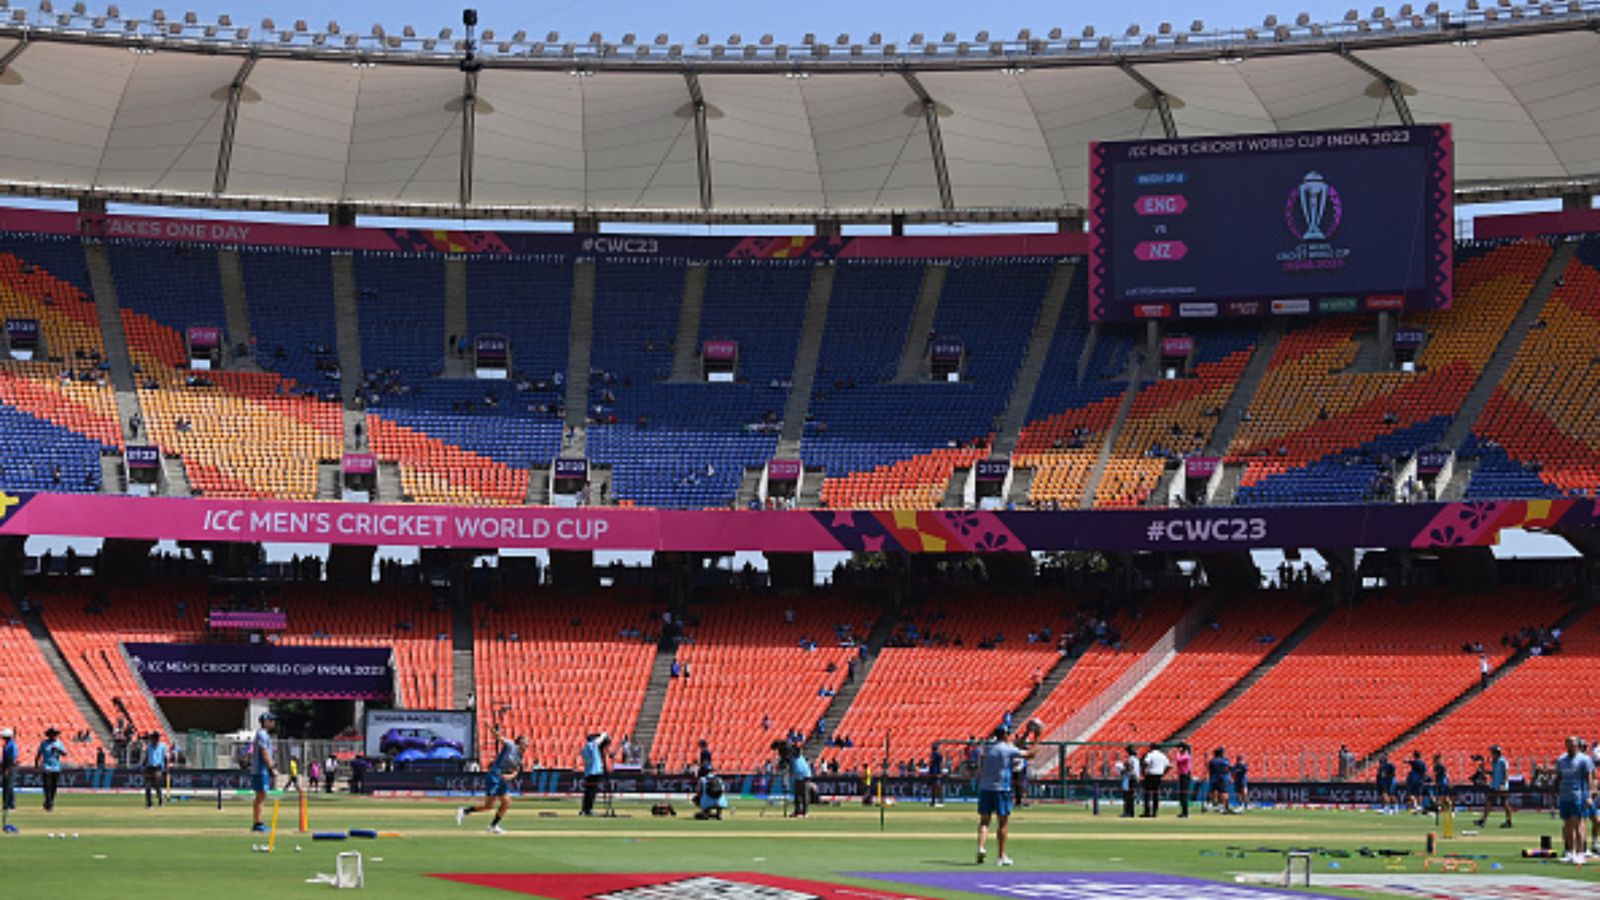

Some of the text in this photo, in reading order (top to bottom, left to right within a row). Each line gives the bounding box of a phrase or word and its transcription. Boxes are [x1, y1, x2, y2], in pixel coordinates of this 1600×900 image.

[1190, 141, 1243, 154] CRICKET
[1247, 138, 1295, 150] WORLD
[1298, 135, 1325, 148] CUP
[1327, 133, 1369, 146] INDIA
[1370, 130, 1410, 144] 2023
[1144, 198, 1177, 213] ENG
[166, 222, 206, 238] ONE
[211, 224, 249, 240] DAY
[581, 238, 659, 253] #CWC23
[1149, 242, 1172, 258] NZ
[203, 509, 609, 540] ICC MEN'S CRICKET WORLD CUP
[1146, 518, 1267, 541] #CWC23
[201, 662, 248, 673] CRICKET
[250, 663, 292, 675] WORLD
[293, 663, 316, 675] CUP
[317, 664, 351, 675] INDIA
[1281, 789, 1310, 801] THE
